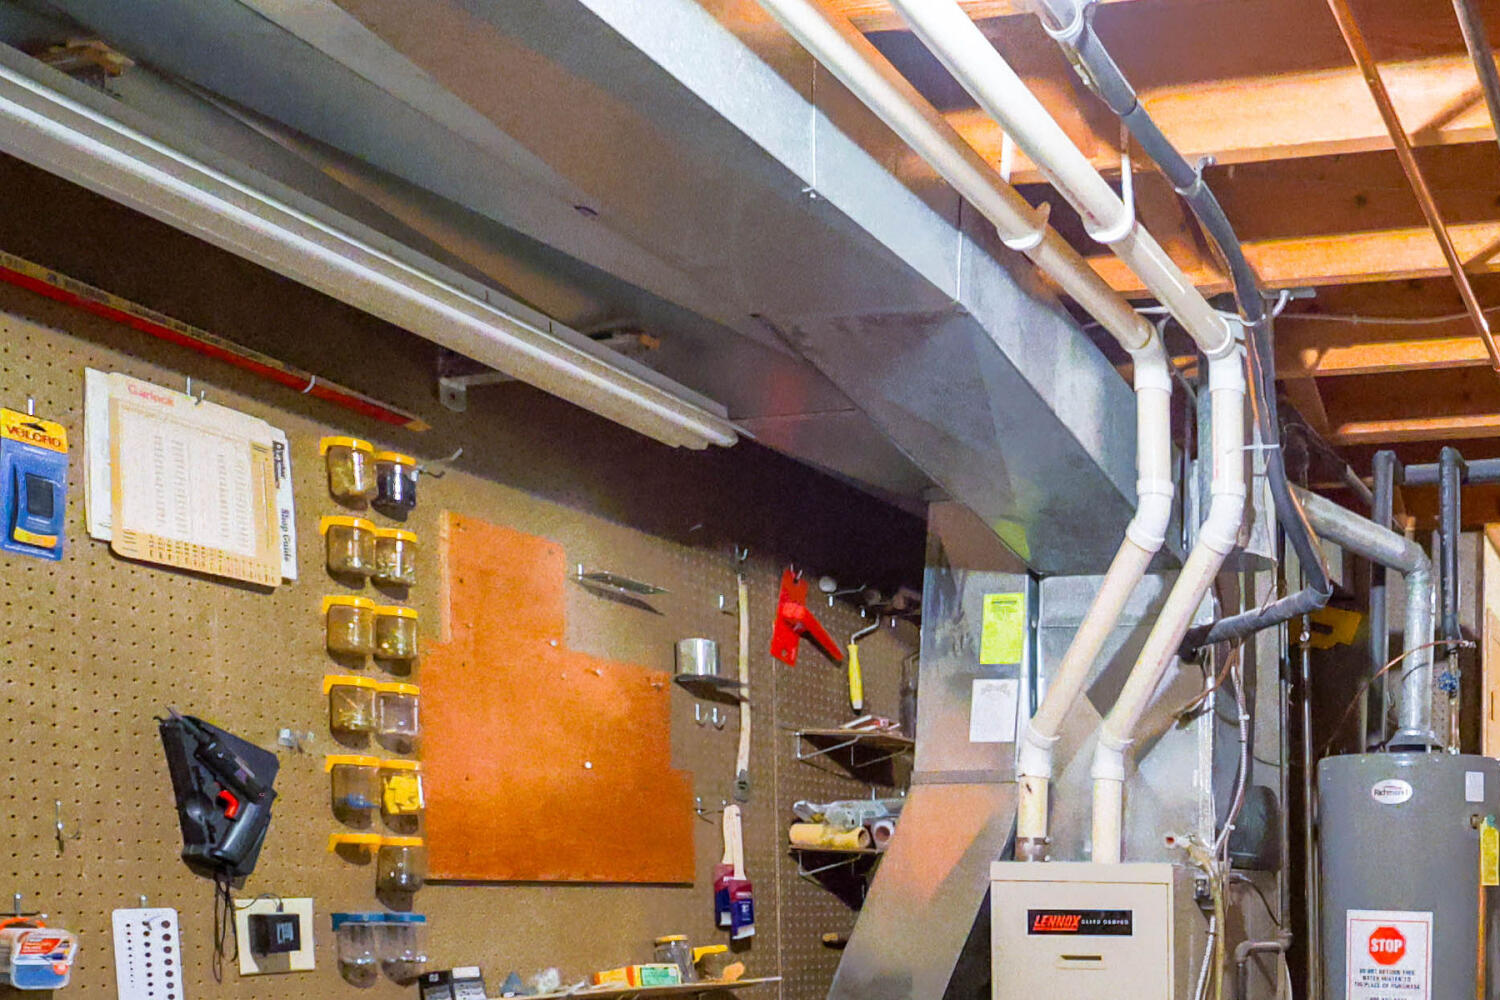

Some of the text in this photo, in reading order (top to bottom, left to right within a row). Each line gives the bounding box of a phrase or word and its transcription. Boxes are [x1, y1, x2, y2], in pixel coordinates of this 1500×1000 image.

[6, 425, 61, 448] VELCRO
[1033, 915, 1081, 927] LENNOX
[1371, 938, 1403, 953] STOP
